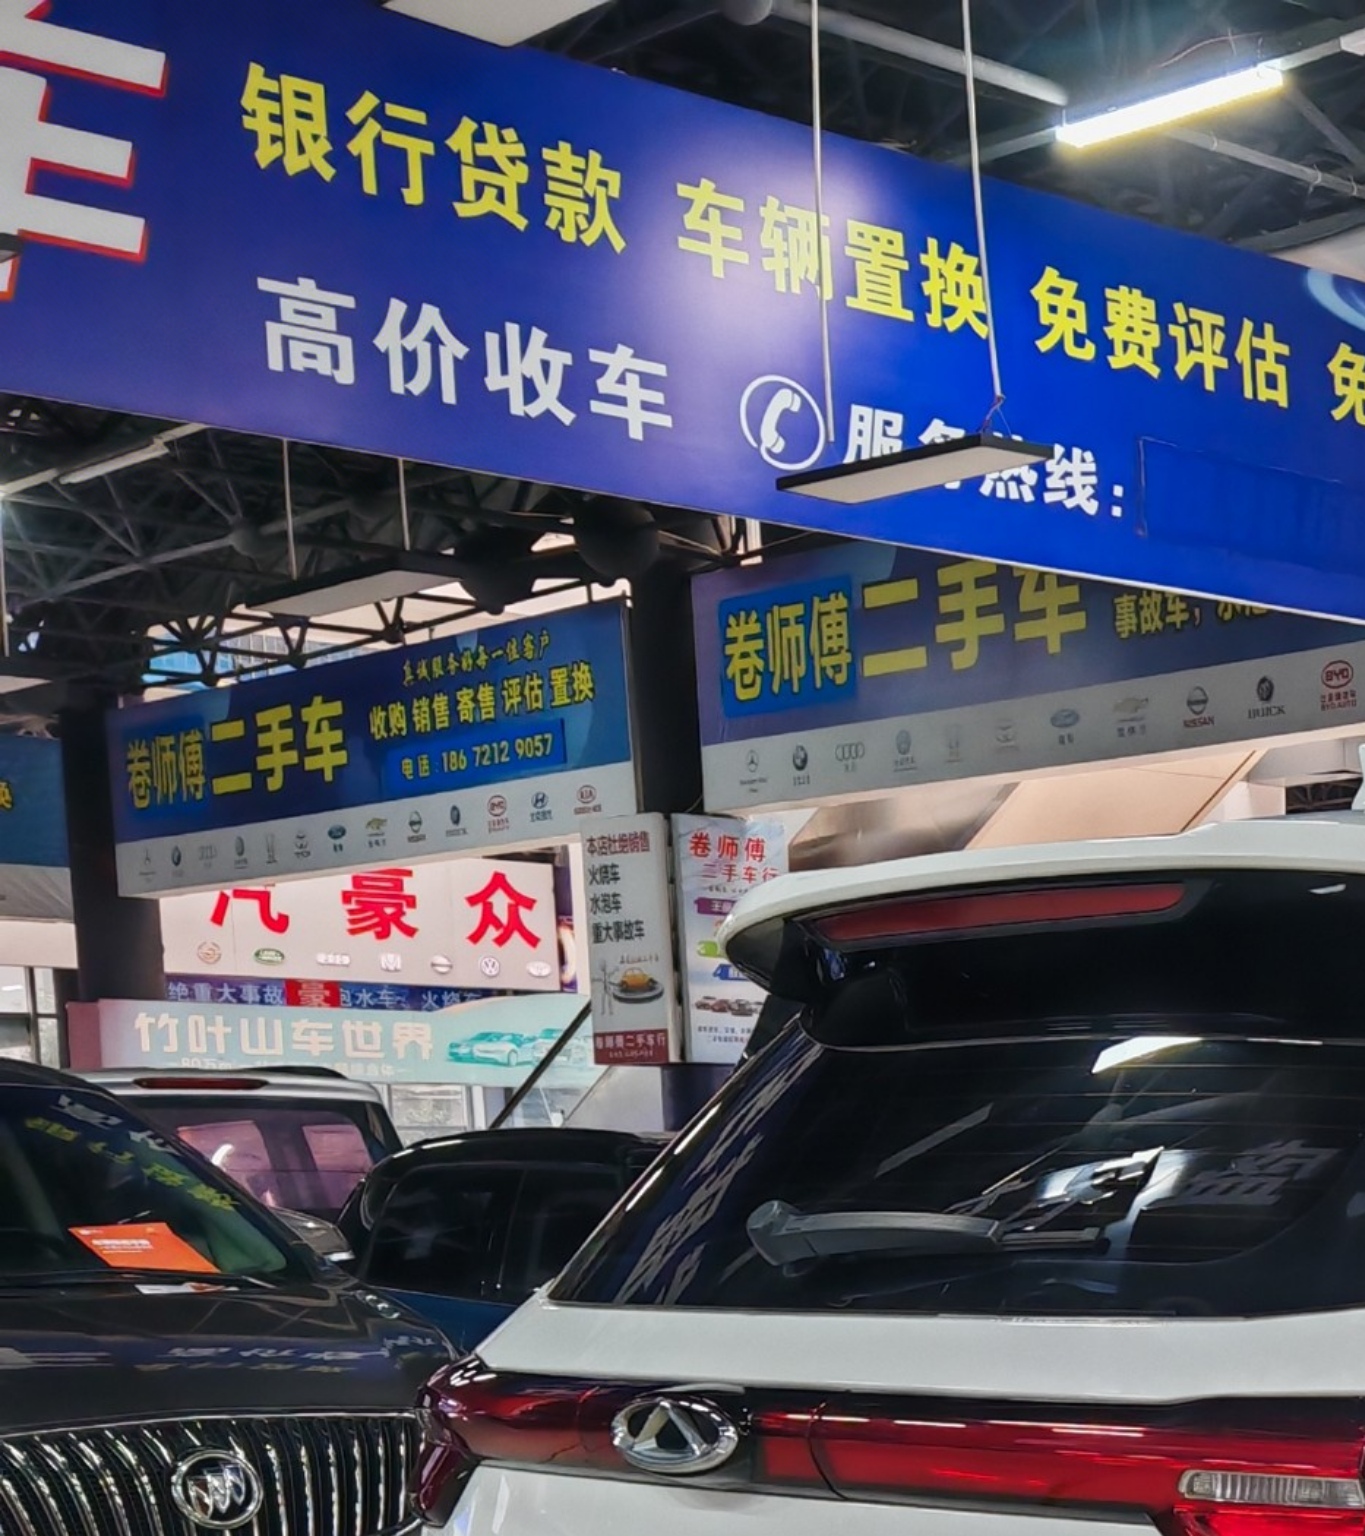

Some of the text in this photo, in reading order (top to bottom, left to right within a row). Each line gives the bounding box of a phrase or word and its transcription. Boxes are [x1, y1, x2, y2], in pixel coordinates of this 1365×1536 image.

[240, 62, 626, 253] 银行贷款
[676, 178, 990, 341] 车辆置换
[1030, 266, 1290, 408] 免费评估
[257, 276, 673, 442] 高价收车
[724, 591, 853, 702] 卷师傅
[863, 558, 1087, 678] 二手车
[1325, 667, 1349, 682] BYD
[369, 660, 596, 741] 收购 销售 寄售 评估 置换
[127, 695, 348, 809] 卷师傅 二手车
[441, 749, 468, 772] 186
[472, 741, 511, 767] 7212
[515, 732, 553, 757] 9057
[690, 832, 766, 862] 卷师傅
[588, 863, 621, 886] 火烧车
[701, 864, 780, 885] 二手车行
[590, 893, 622, 915] 水泡车
[592, 919, 645, 944] 重大事故车
[135, 1012, 432, 1060] 竹叶山车世界
